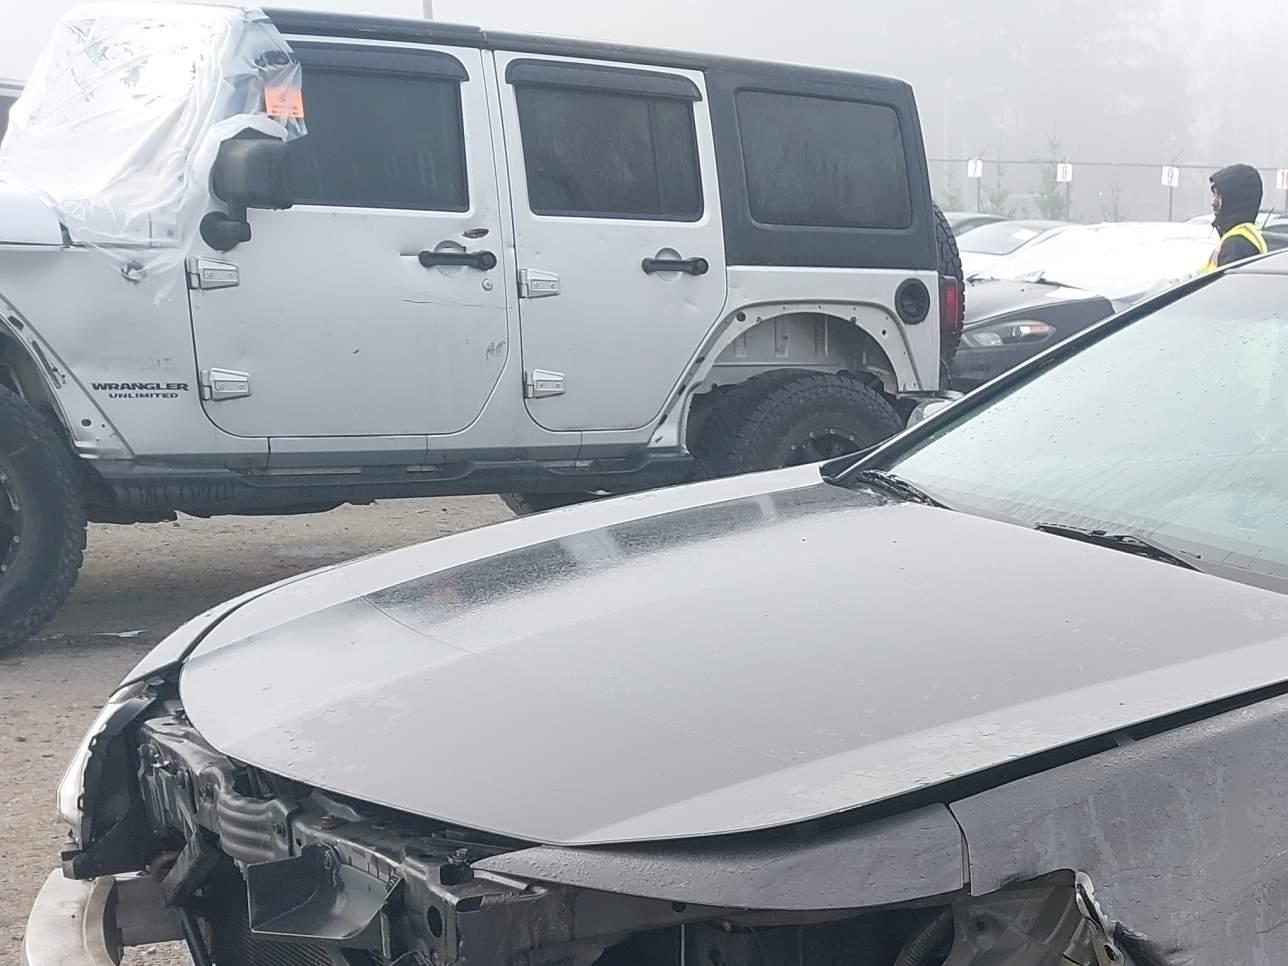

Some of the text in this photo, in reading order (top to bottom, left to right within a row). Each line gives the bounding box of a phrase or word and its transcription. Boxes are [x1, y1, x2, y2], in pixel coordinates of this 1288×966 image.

[1060, 164, 1069, 179] 8
[1166, 168, 1174, 184] 9
[91, 382, 189, 391] WRANGLER
